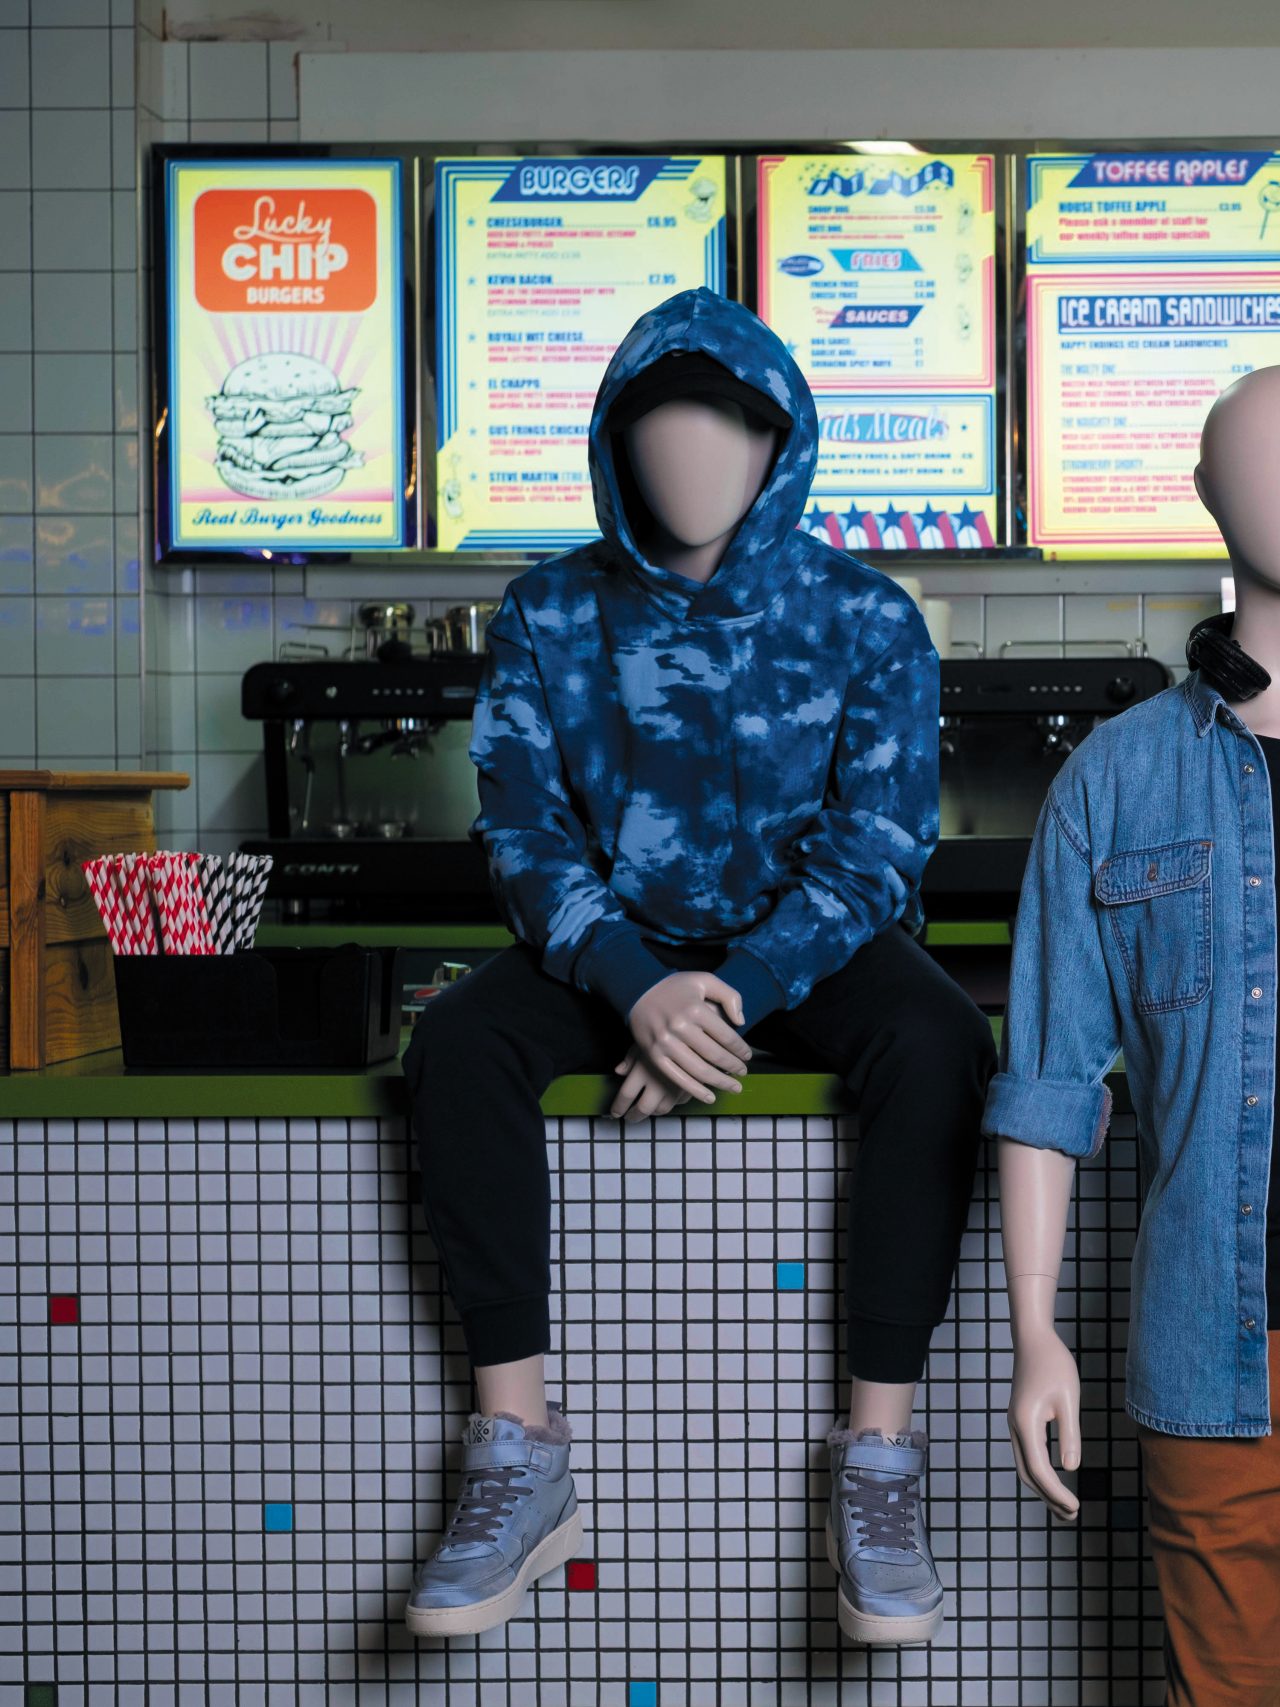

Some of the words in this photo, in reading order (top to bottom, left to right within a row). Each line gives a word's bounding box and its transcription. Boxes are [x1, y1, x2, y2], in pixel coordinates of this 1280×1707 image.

[1093, 161, 1169, 181] TOFFEE
[1175, 159, 1248, 185] APPLES
[520, 166, 640, 195] BURGERS
[1059, 202, 1093, 212] HOUSE
[1097, 202, 1133, 212] TOFFEE
[1136, 201, 1166, 212] APPLE
[234, 196, 331, 248] Lucky
[487, 217, 563, 228] CHEESEBURGER
[1059, 217, 1090, 227] Please
[1120, 217, 1158, 227] member
[1172, 217, 1193, 226] staff
[1077, 231, 1109, 242] weekly
[1113, 231, 1139, 240] toffee
[1143, 230, 1167, 241] apple
[1170, 230, 1211, 241] specials
[221, 243, 349, 281] CHIP
[850, 251, 901, 270] FRIES
[487, 275, 515, 285] KEVIN
[519, 275, 552, 285] BACON
[246, 287, 325, 304] BURGERS
[845, 310, 908, 323] SAUCES
[1061, 299, 1090, 326] ICE
[1094, 298, 1161, 326] CREAM
[488, 332, 522, 342] ROYALE
[548, 332, 583, 342] CHEESE
[1061, 341, 1086, 349] HAPPY
[1143, 340, 1170, 348] CREAM
[1174, 339, 1228, 348] SANDWICHES
[866, 405, 950, 441] Meals
[489, 472, 518, 482] STEVE
[522, 472, 558, 482] MARTIN
[192, 508, 236, 525] Real
[240, 508, 303, 531] Burger
[308, 507, 383, 528] Goodness
[284, 864, 360, 874] CONTI
